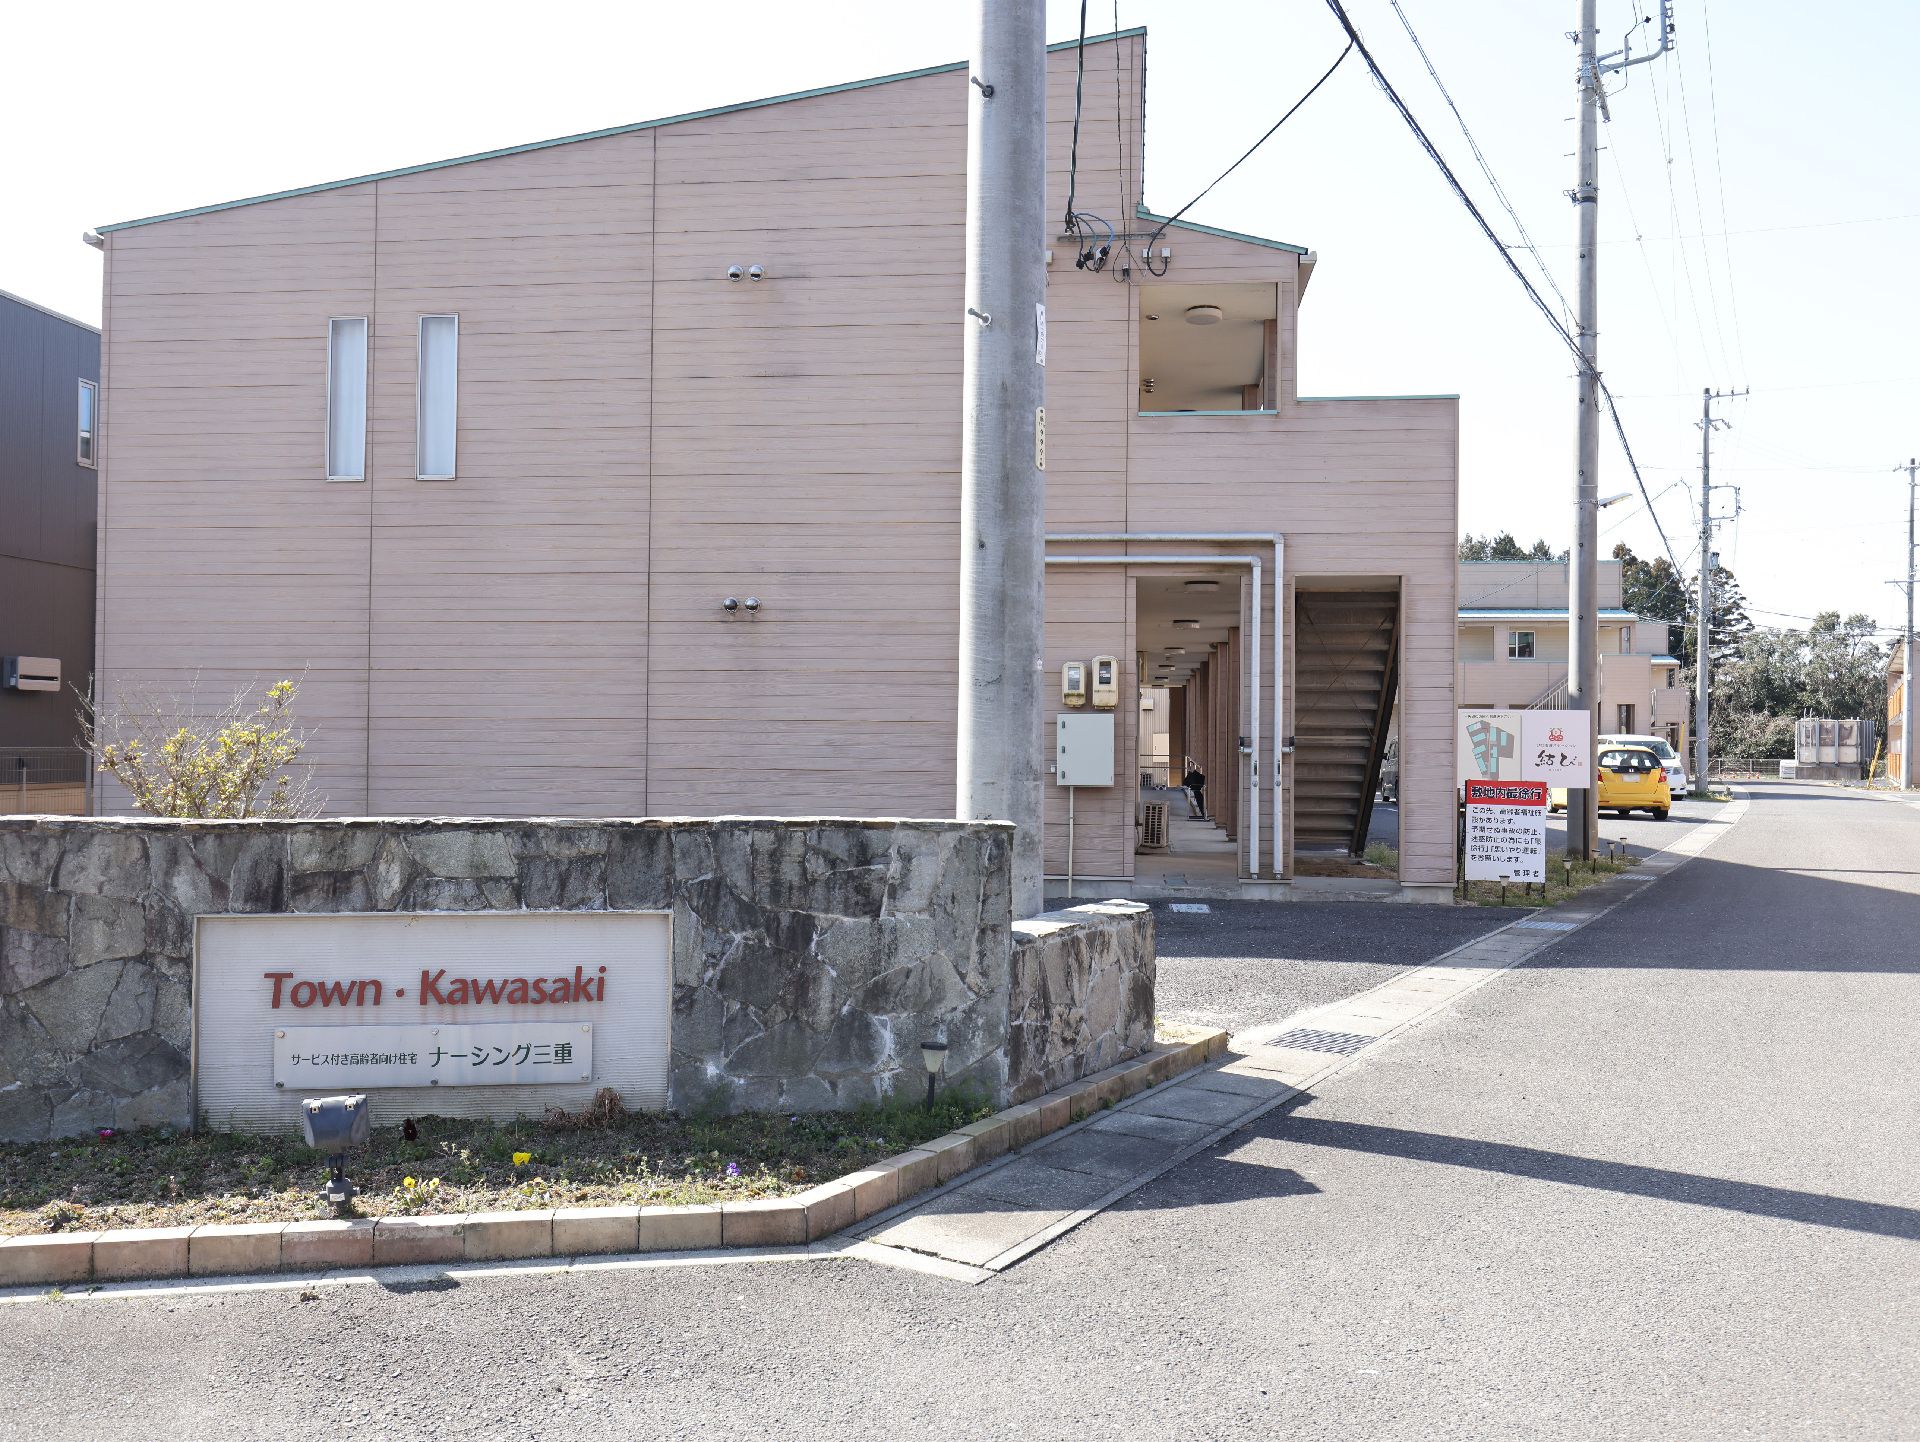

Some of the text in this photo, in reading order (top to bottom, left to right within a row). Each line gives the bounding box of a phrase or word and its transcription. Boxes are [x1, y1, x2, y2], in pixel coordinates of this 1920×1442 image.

[1471, 785, 1542, 801] 敷地内最徐行
[263, 971, 383, 1010] Town
[419, 965, 608, 1007] Kawasaki
[291, 1042, 574, 1068] サービス付き高齢者向け住宅 ナーシング三重
